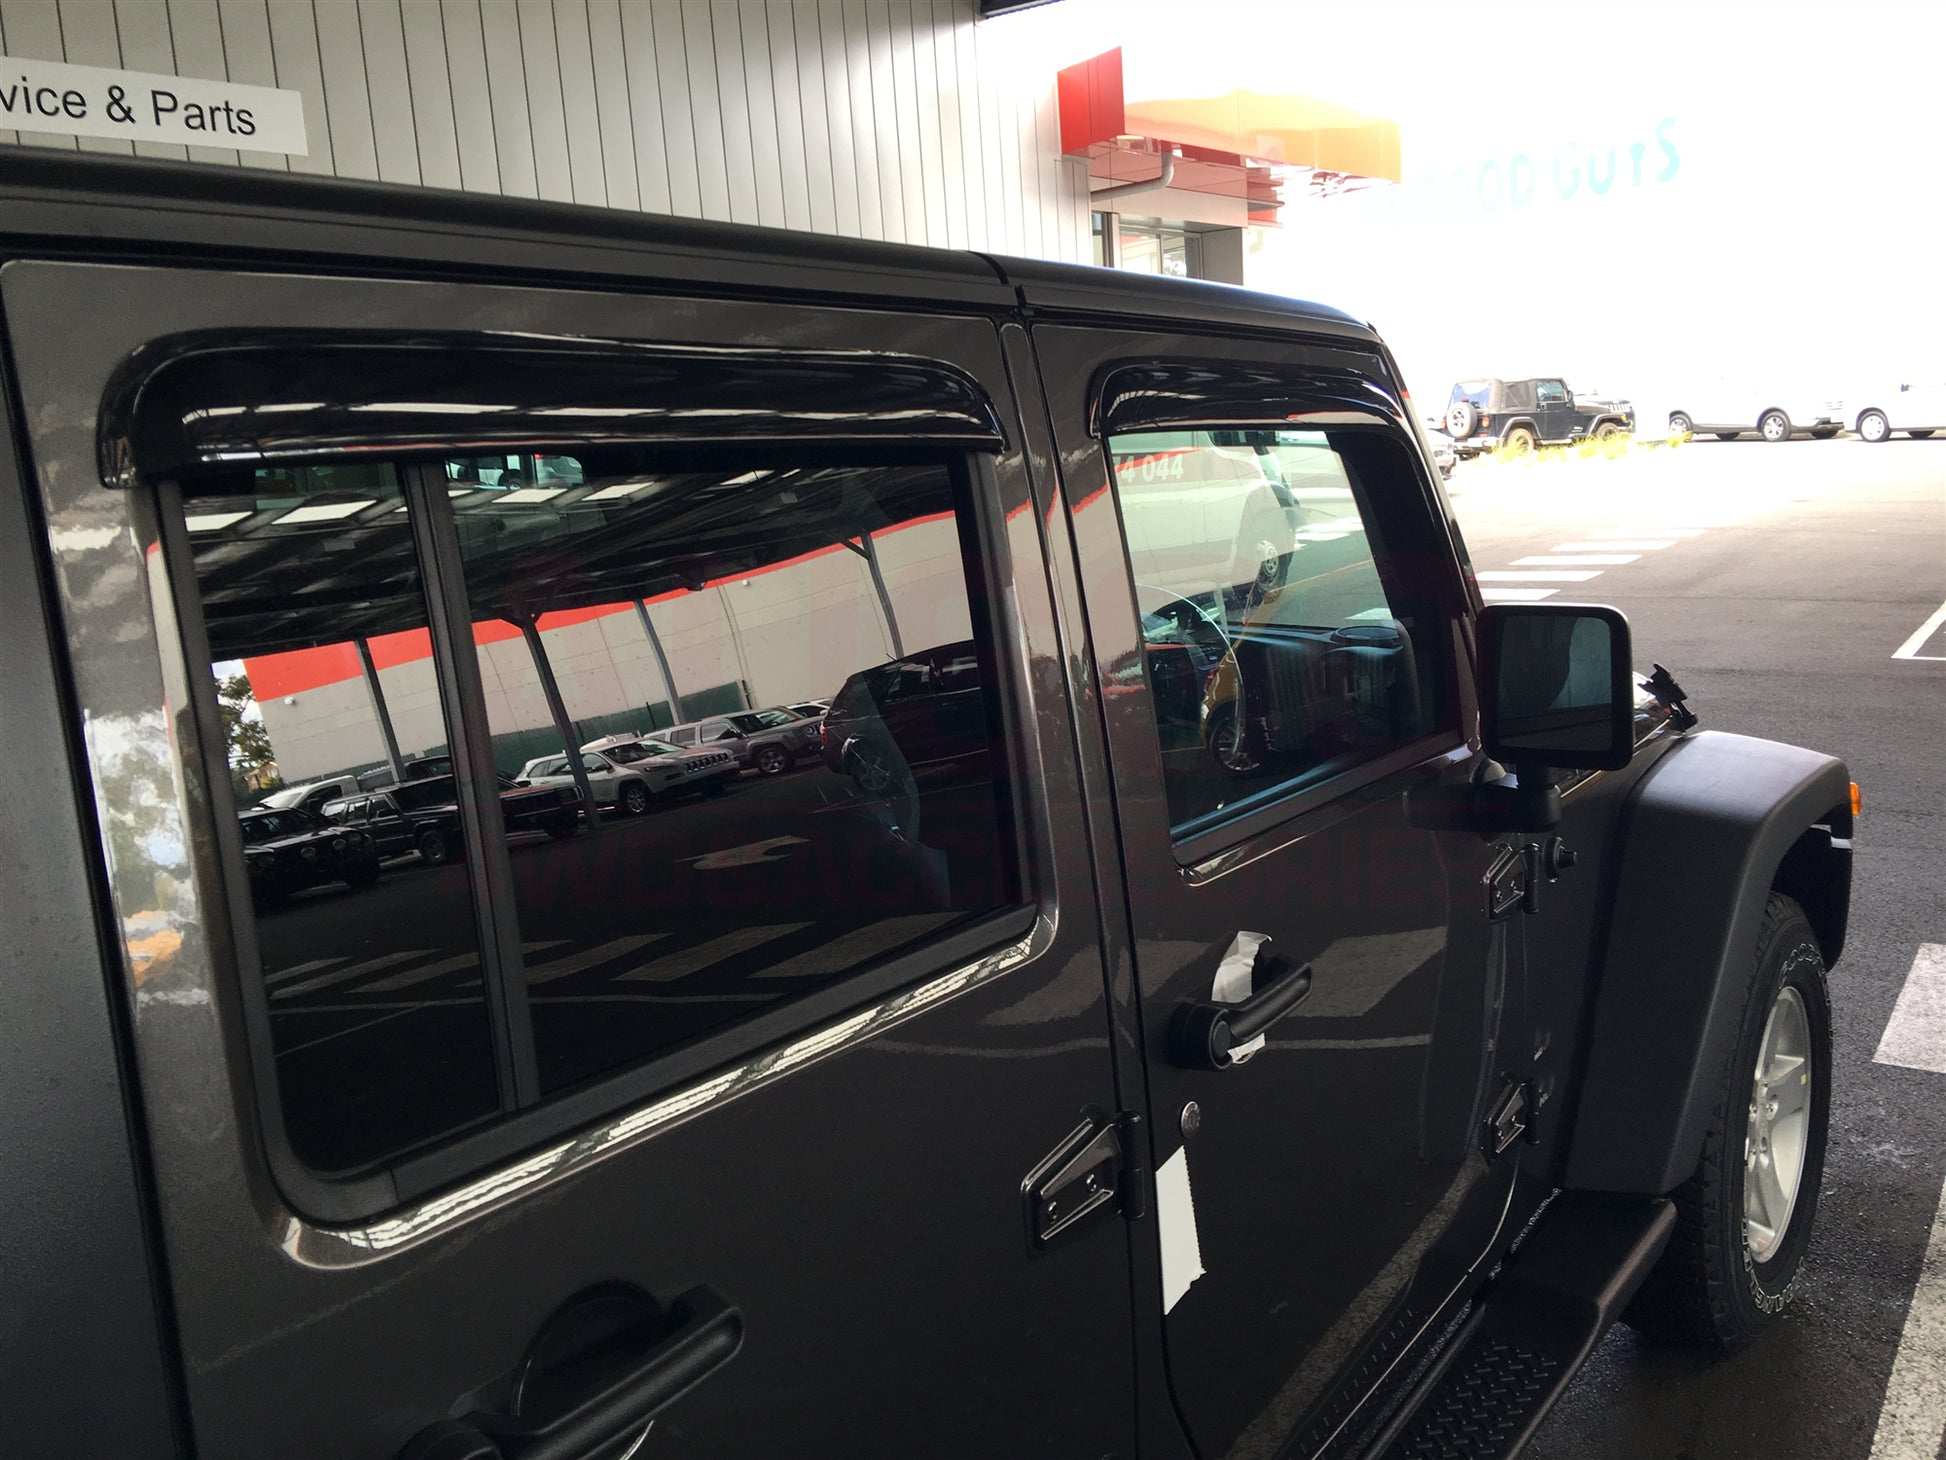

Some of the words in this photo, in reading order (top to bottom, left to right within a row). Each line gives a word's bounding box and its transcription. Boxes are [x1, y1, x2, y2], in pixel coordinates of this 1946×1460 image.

[105, 85, 137, 124] &
[150, 89, 257, 136] Parts
[1142, 453, 1184, 482] 044
